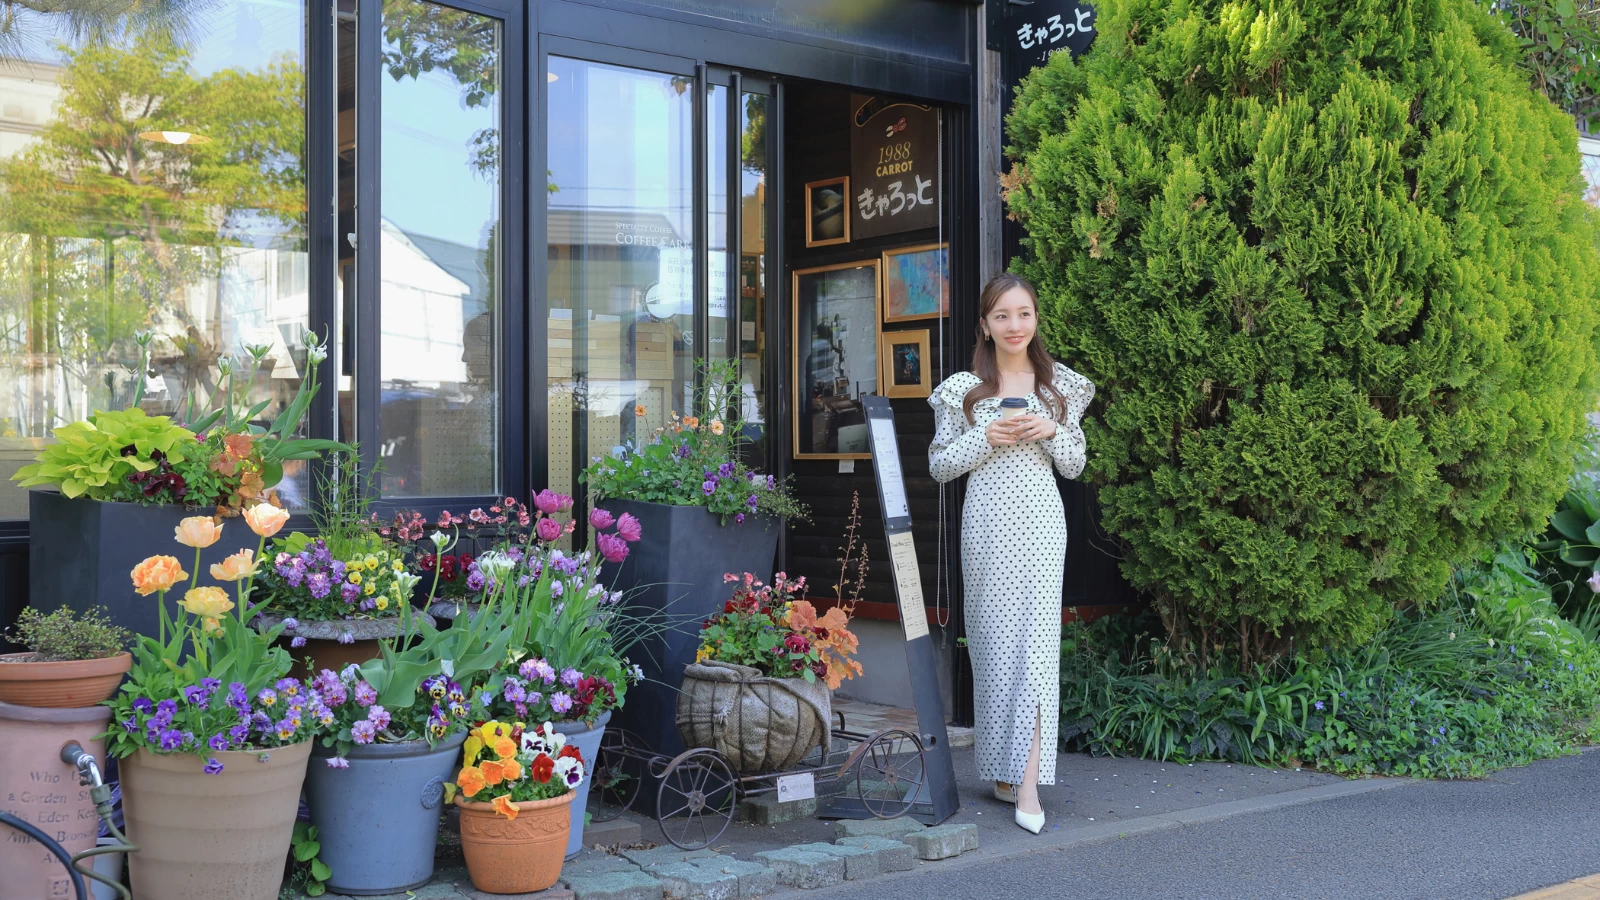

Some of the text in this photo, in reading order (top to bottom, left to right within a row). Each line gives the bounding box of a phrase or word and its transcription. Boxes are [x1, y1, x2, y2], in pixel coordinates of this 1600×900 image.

[1016, 7, 1093, 50] きゃろっと
[878, 141, 911, 165] 1988
[875, 160, 914, 177] CARROT
[857, 174, 934, 220] きゃろっと
[615, 231, 657, 247] COFFEE
[30, 771, 60, 784] Who
